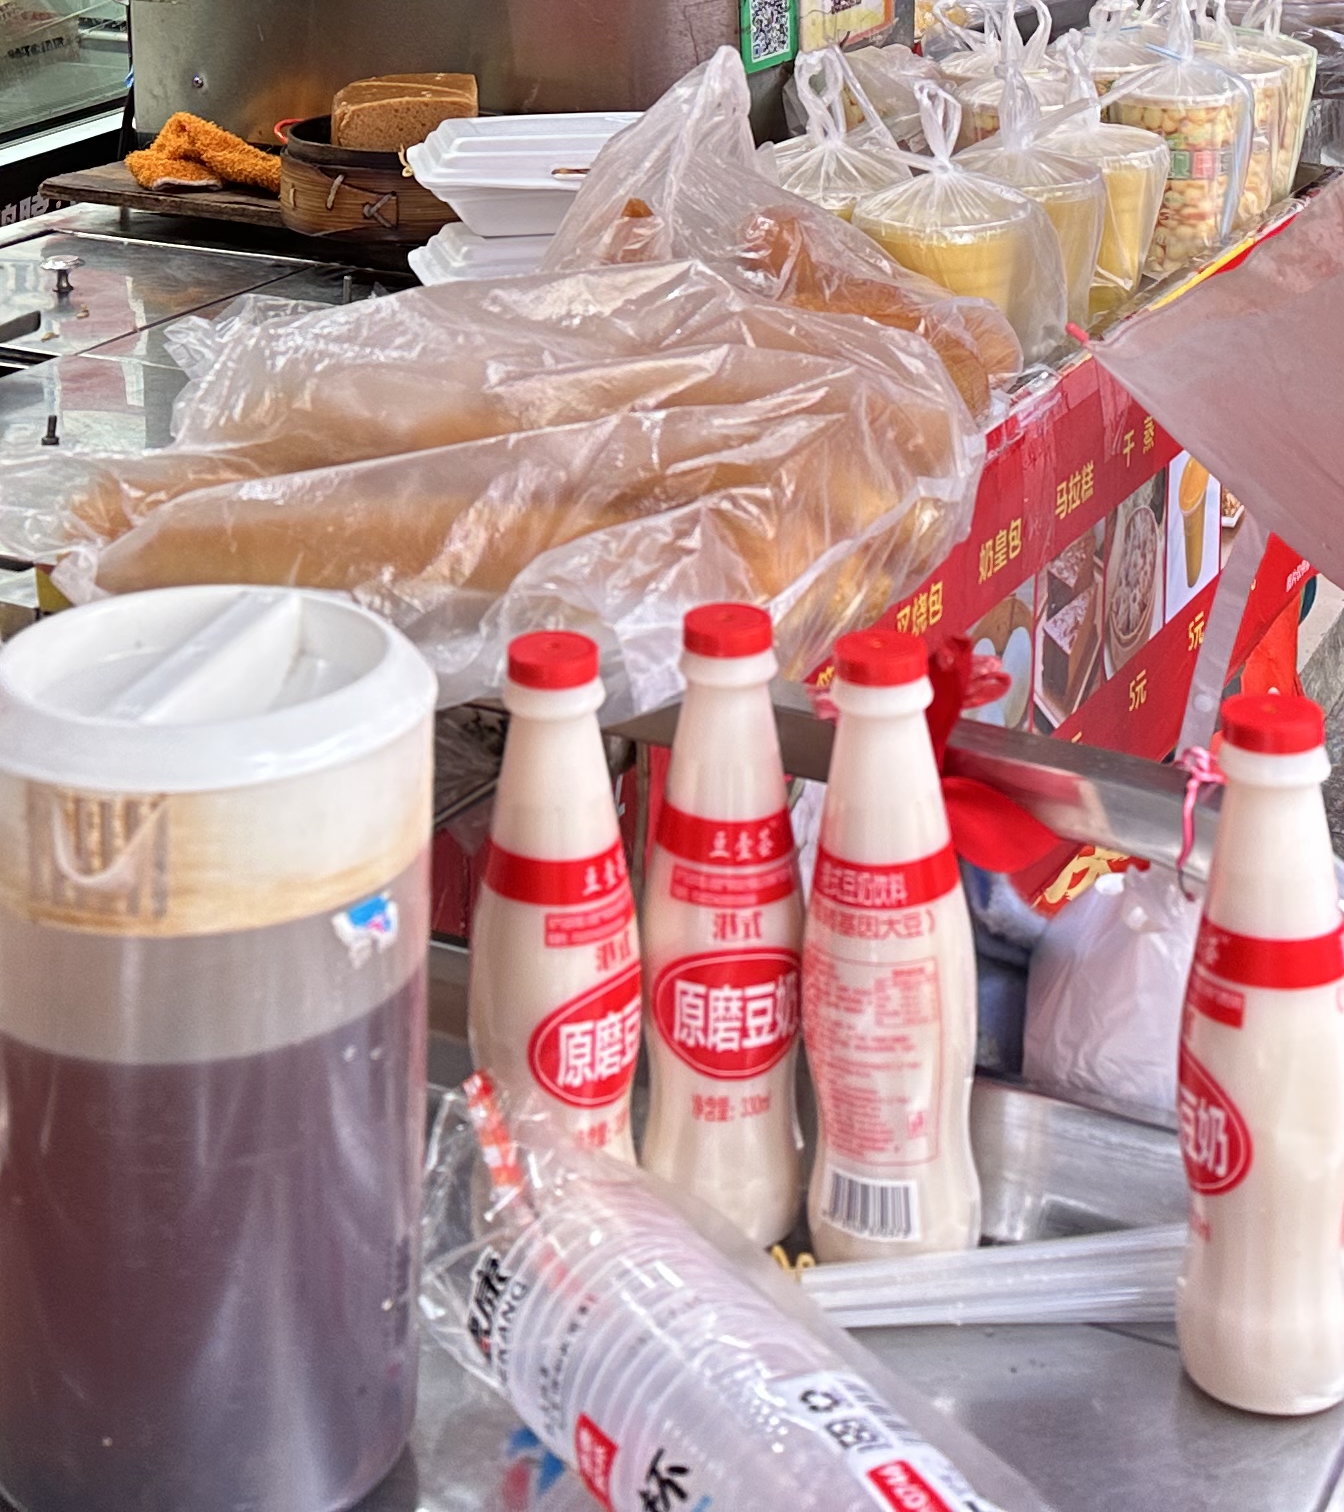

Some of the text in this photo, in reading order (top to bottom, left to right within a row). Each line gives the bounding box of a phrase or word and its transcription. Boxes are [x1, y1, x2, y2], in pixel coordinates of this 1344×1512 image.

[1055, 460, 1094, 520] 马拉糕
[978, 518, 1022, 585] 奶皇包
[1129, 669, 1147, 712] 5元
